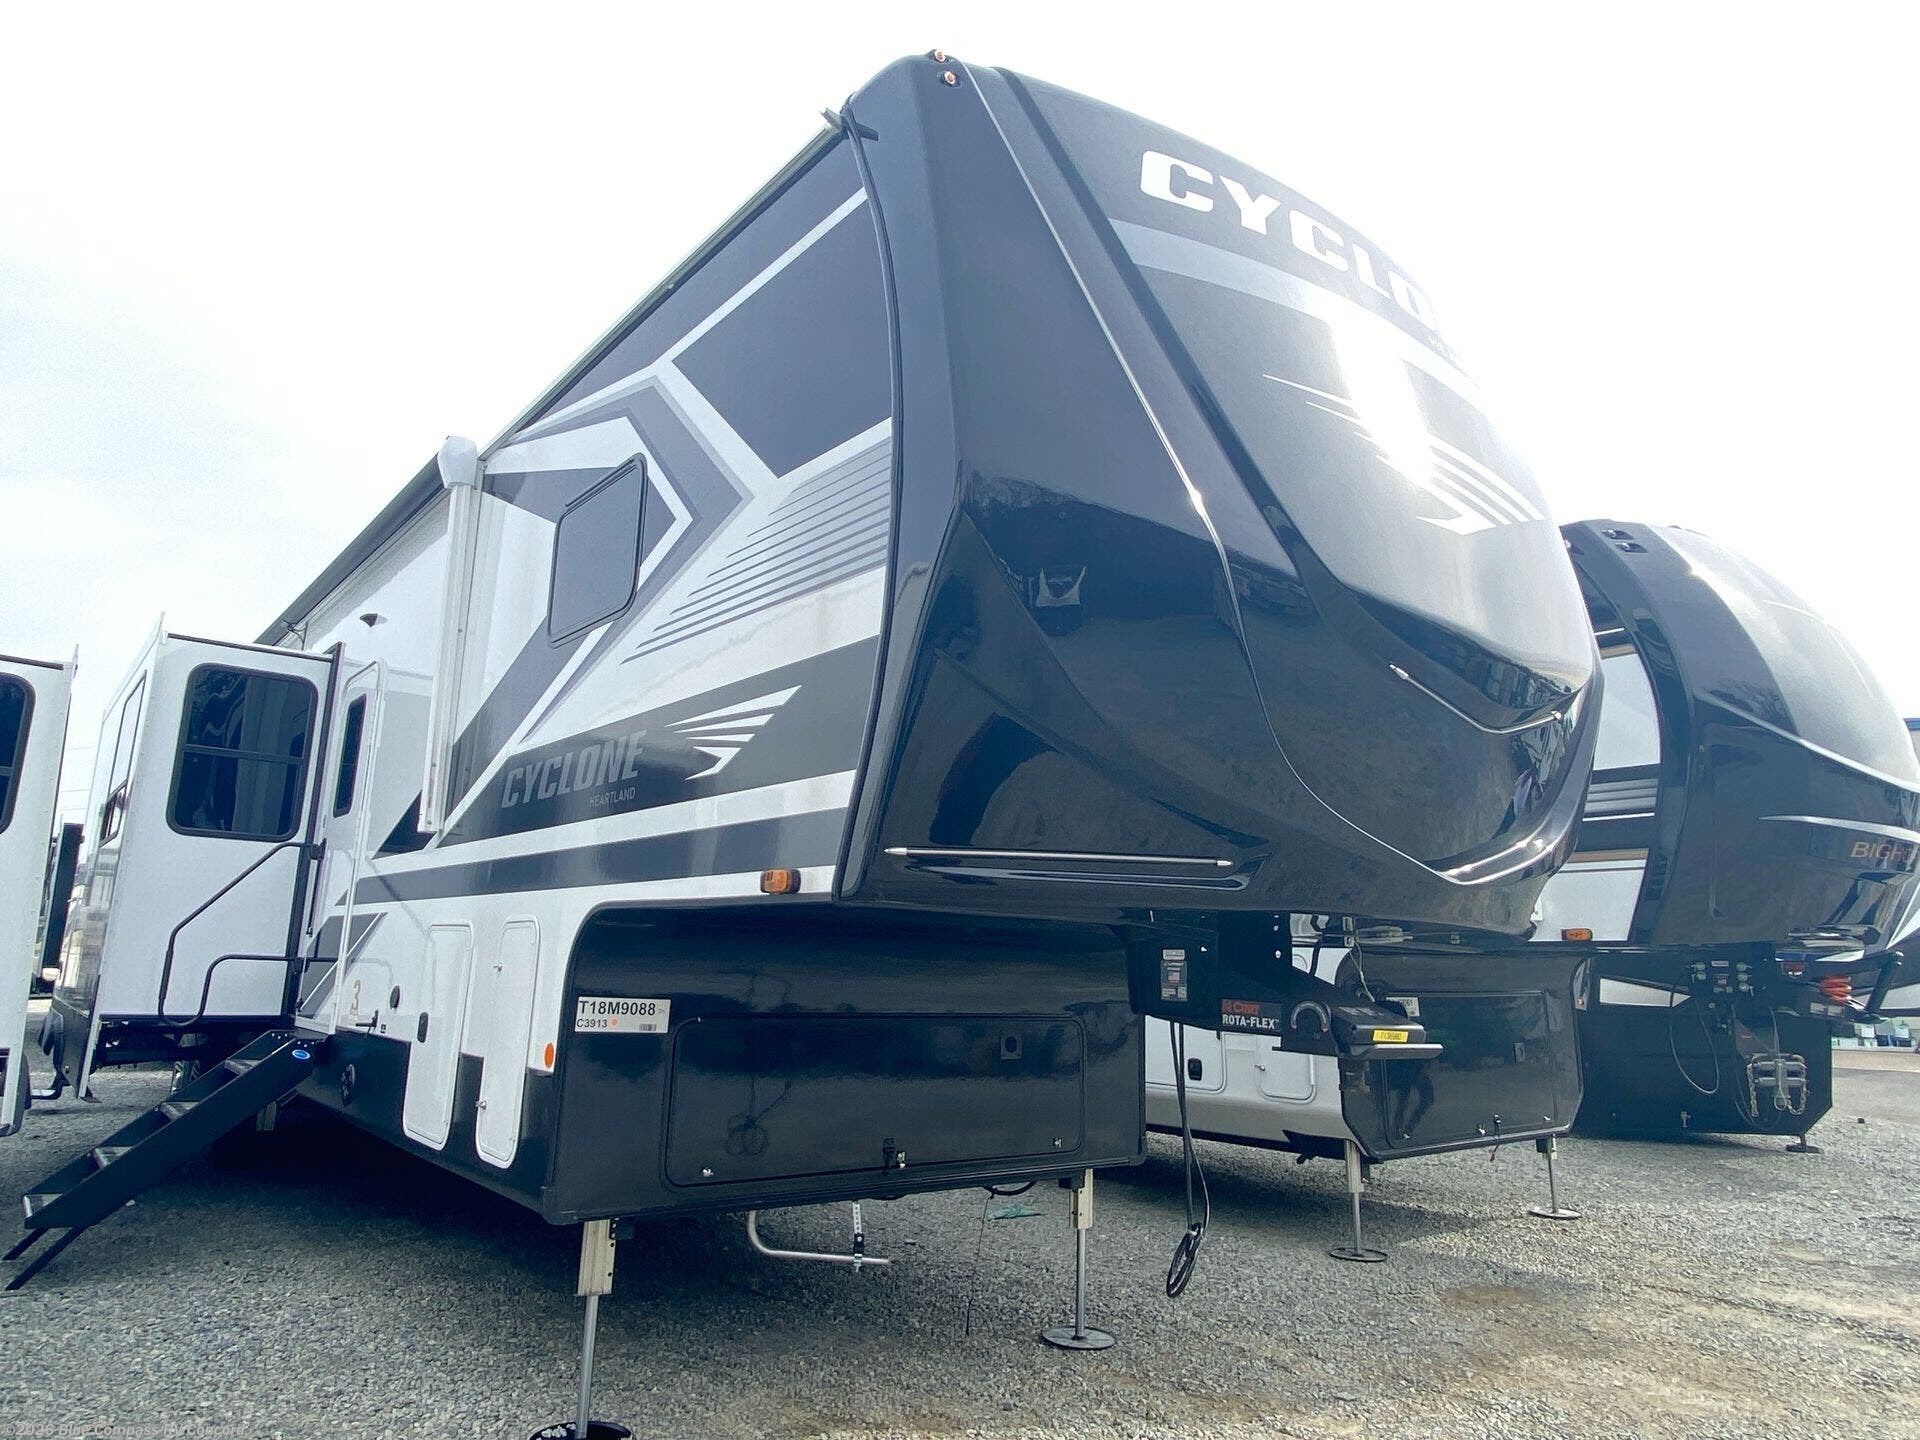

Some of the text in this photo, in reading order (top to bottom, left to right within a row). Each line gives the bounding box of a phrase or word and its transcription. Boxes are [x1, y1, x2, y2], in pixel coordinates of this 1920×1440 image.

[1139, 149, 1438, 332] CYCLO
[501, 729, 648, 809] CYCLONE
[588, 785, 636, 809] HEARTLAND
[579, 1000, 656, 1016] T18M9088
[576, 1018, 608, 1028] C3913
